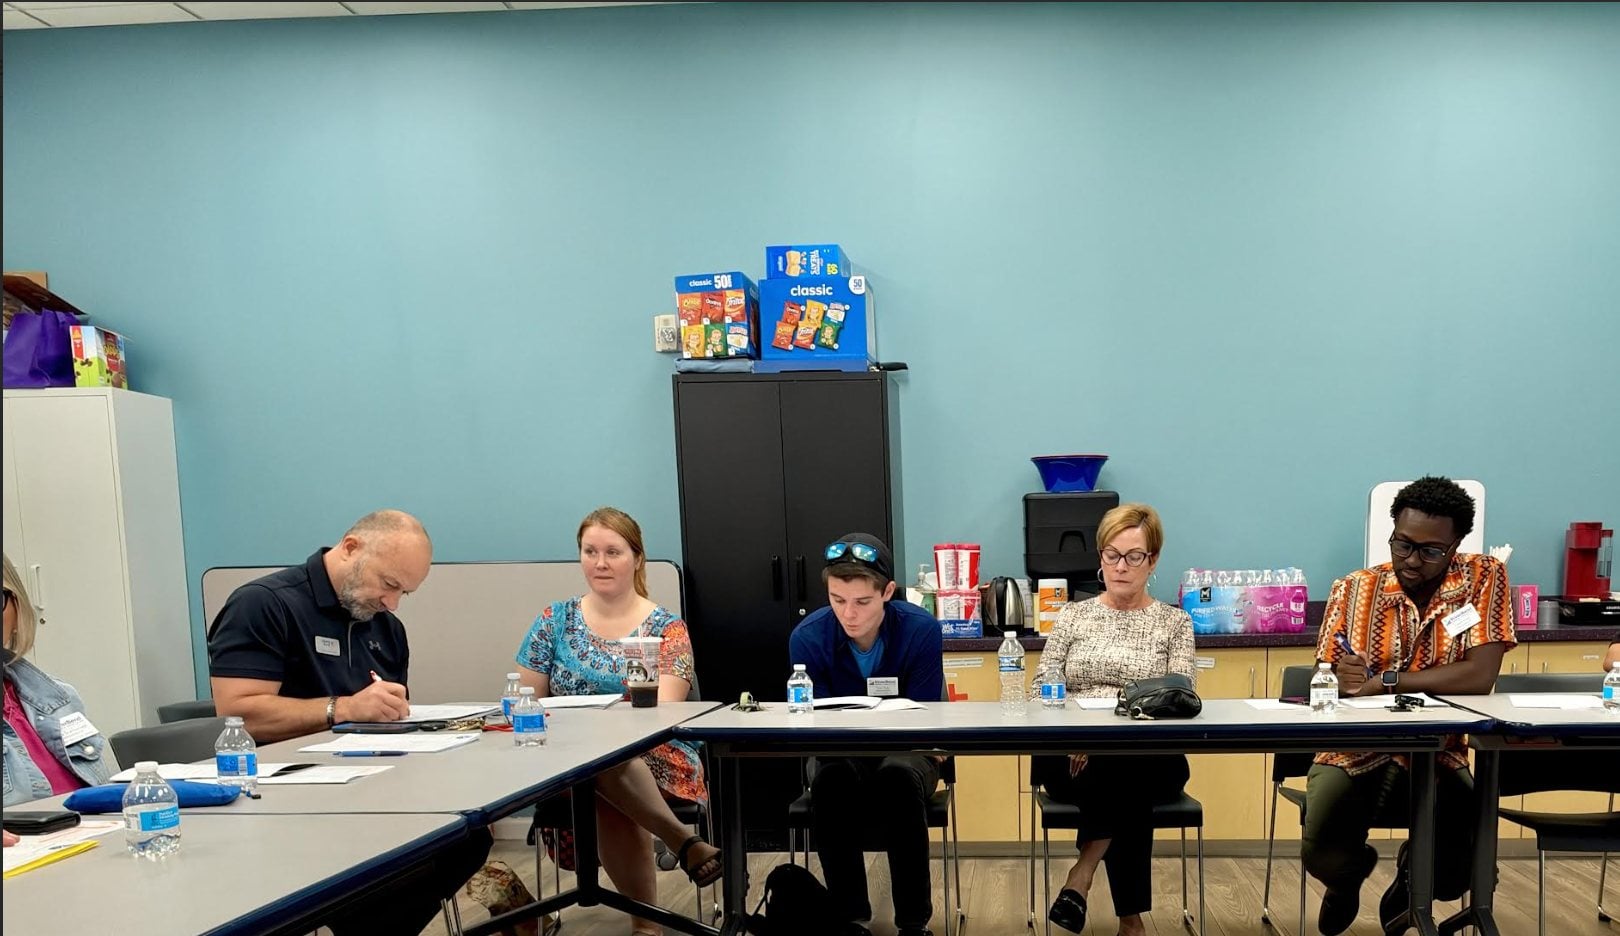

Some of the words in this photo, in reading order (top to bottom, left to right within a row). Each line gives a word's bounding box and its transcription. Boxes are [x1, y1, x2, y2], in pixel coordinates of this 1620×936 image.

[714, 275, 727, 289] 50
[853, 278, 863, 288] 50
[790, 284, 833, 296] classic
